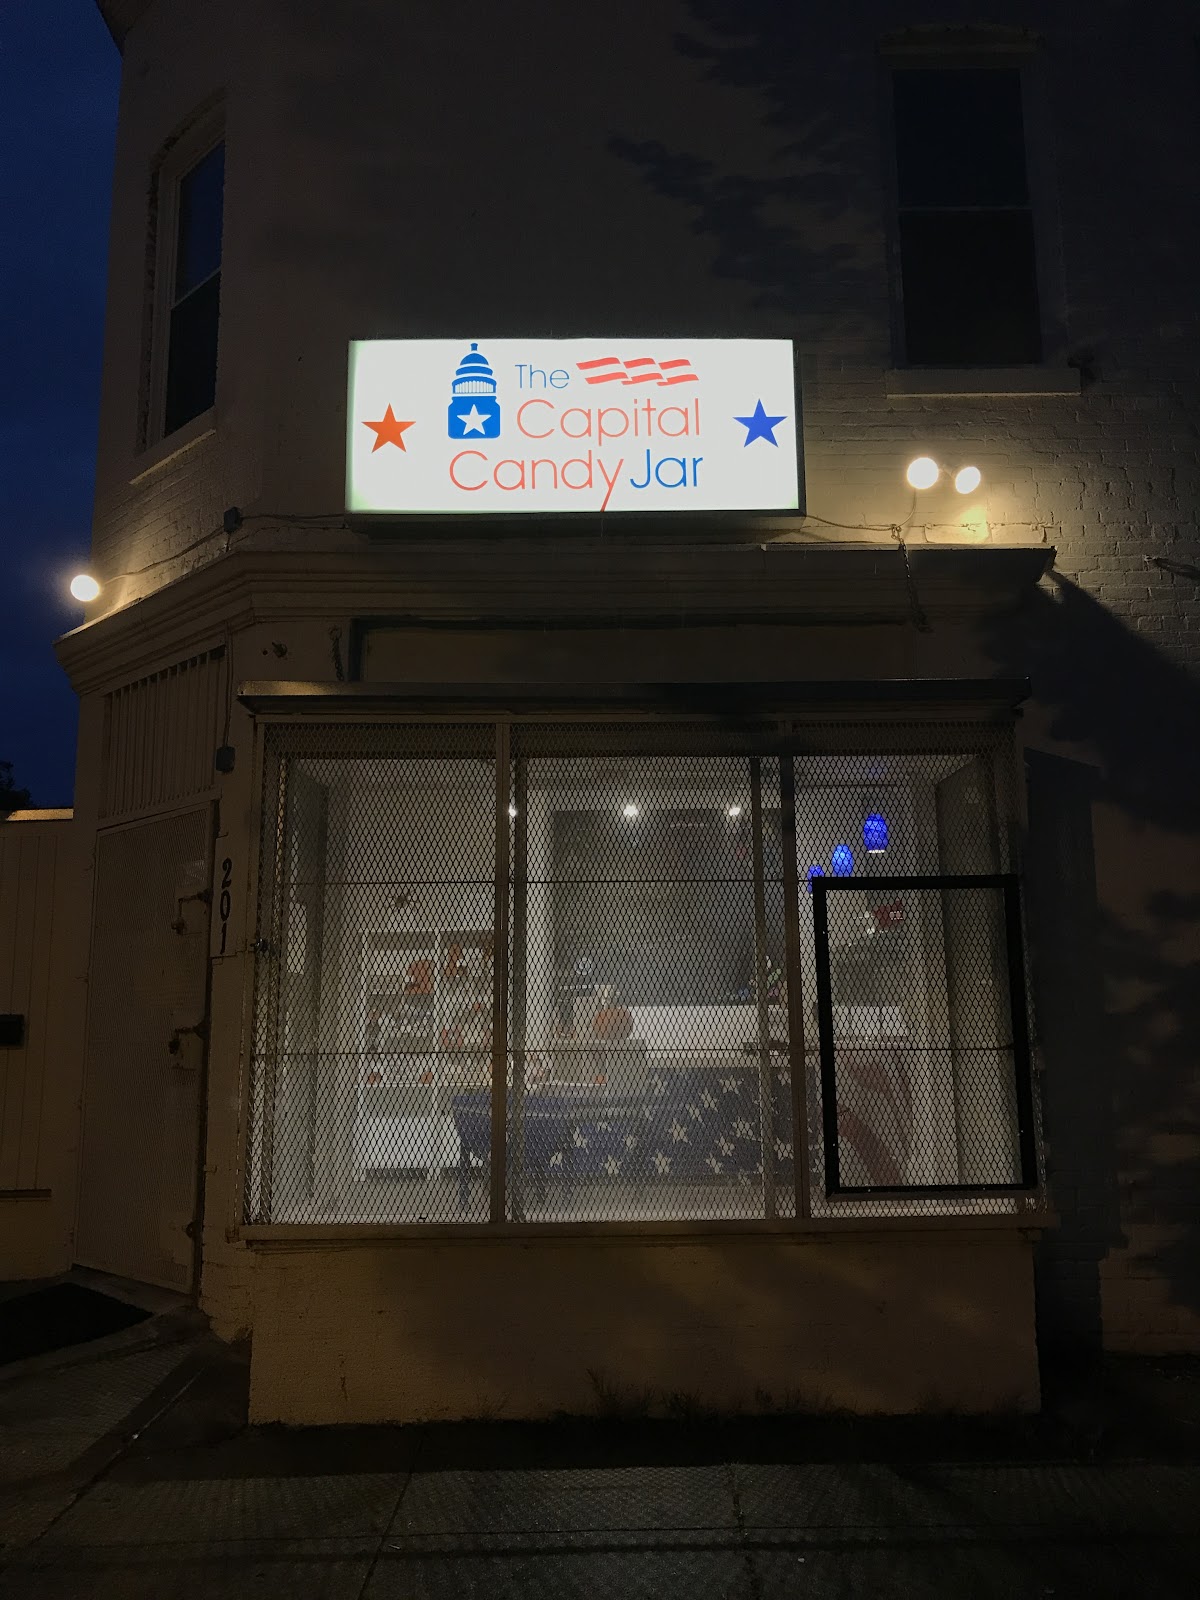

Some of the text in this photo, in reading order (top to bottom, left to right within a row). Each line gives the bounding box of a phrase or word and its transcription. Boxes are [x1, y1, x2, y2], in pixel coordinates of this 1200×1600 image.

[515, 364, 570, 389] The
[517, 398, 701, 446] Capital
[449, 448, 704, 512] Candy Jar
[220, 858, 232, 955] 201
